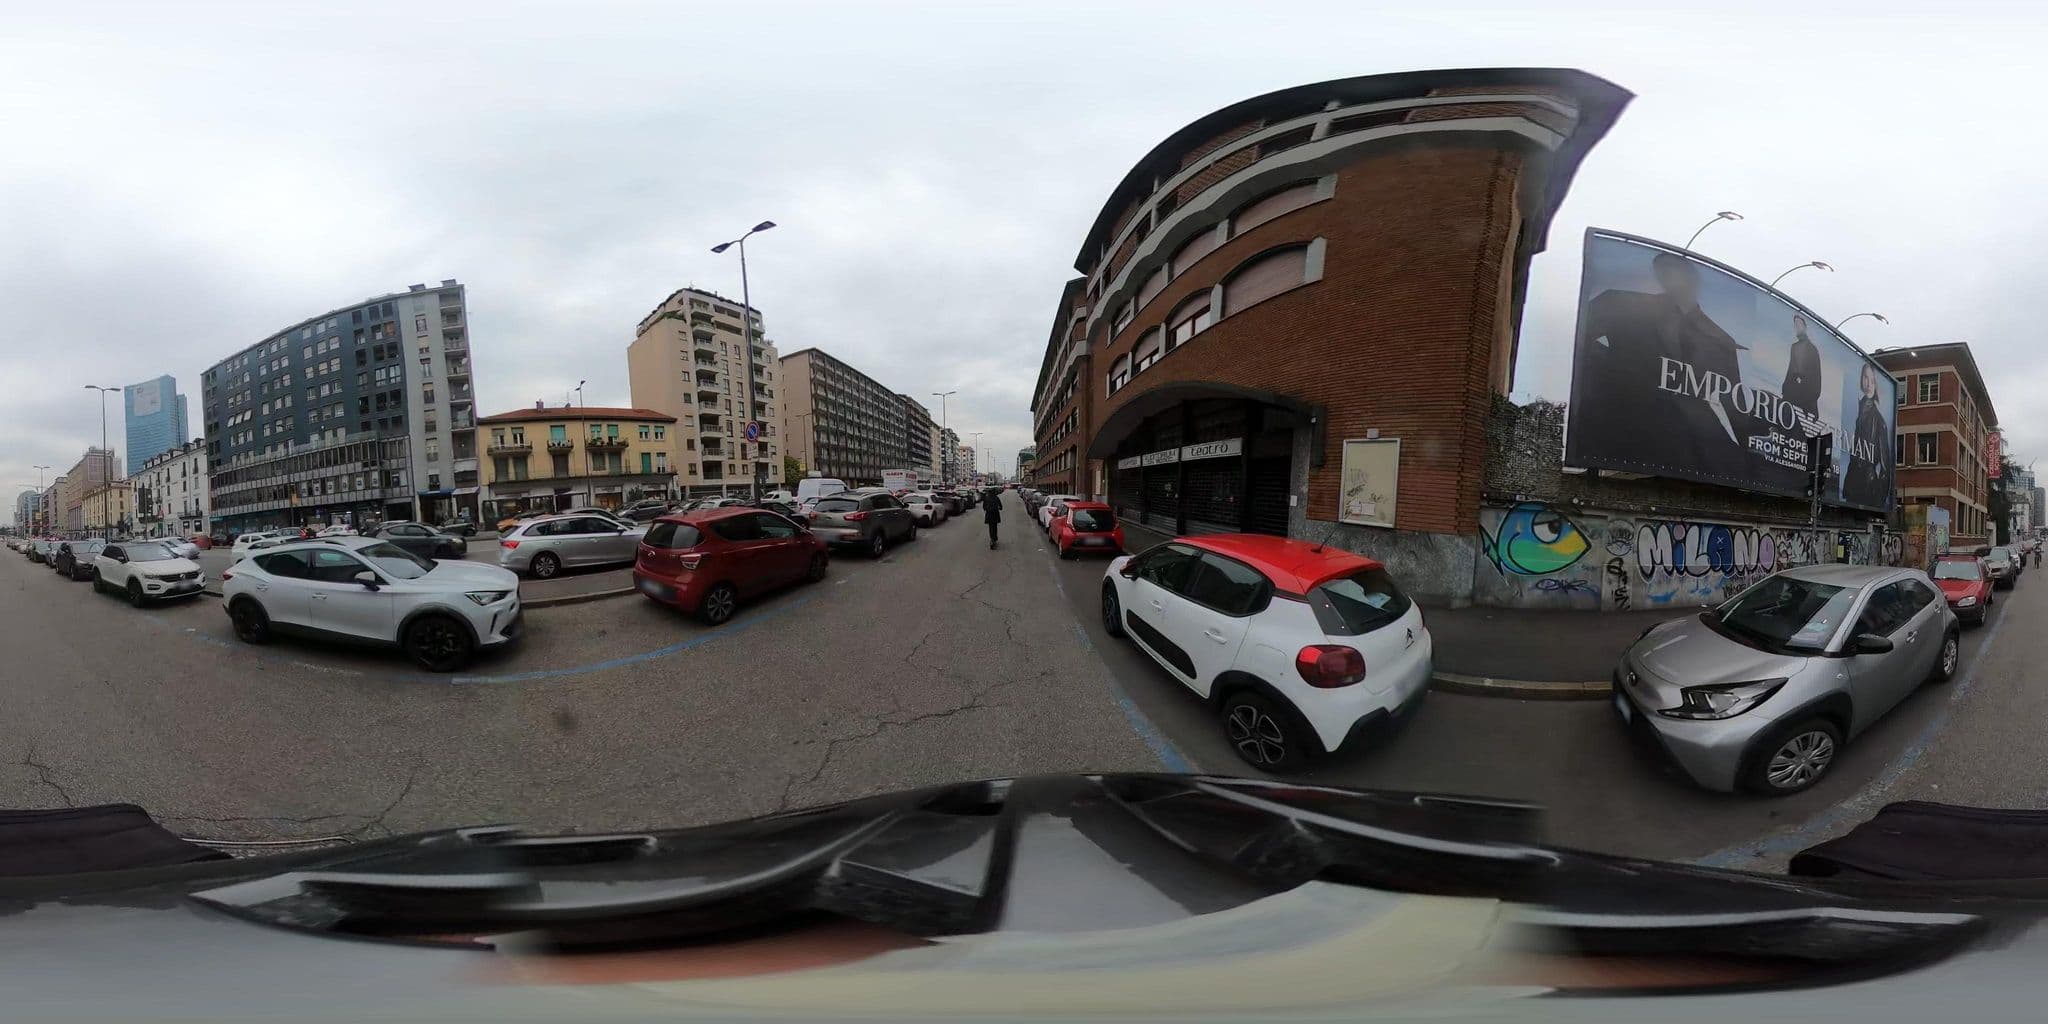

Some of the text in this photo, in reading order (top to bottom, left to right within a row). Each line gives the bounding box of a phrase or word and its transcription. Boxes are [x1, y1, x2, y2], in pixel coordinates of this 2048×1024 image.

[1658, 356, 1796, 431] EMPORIO
[1191, 442, 1229, 457] teatro
[1748, 436, 1780, 457] FROM
[1771, 431, 1809, 452] RE-OPE
[1764, 454, 1840, 475] VIA ALESSANDRO 18
